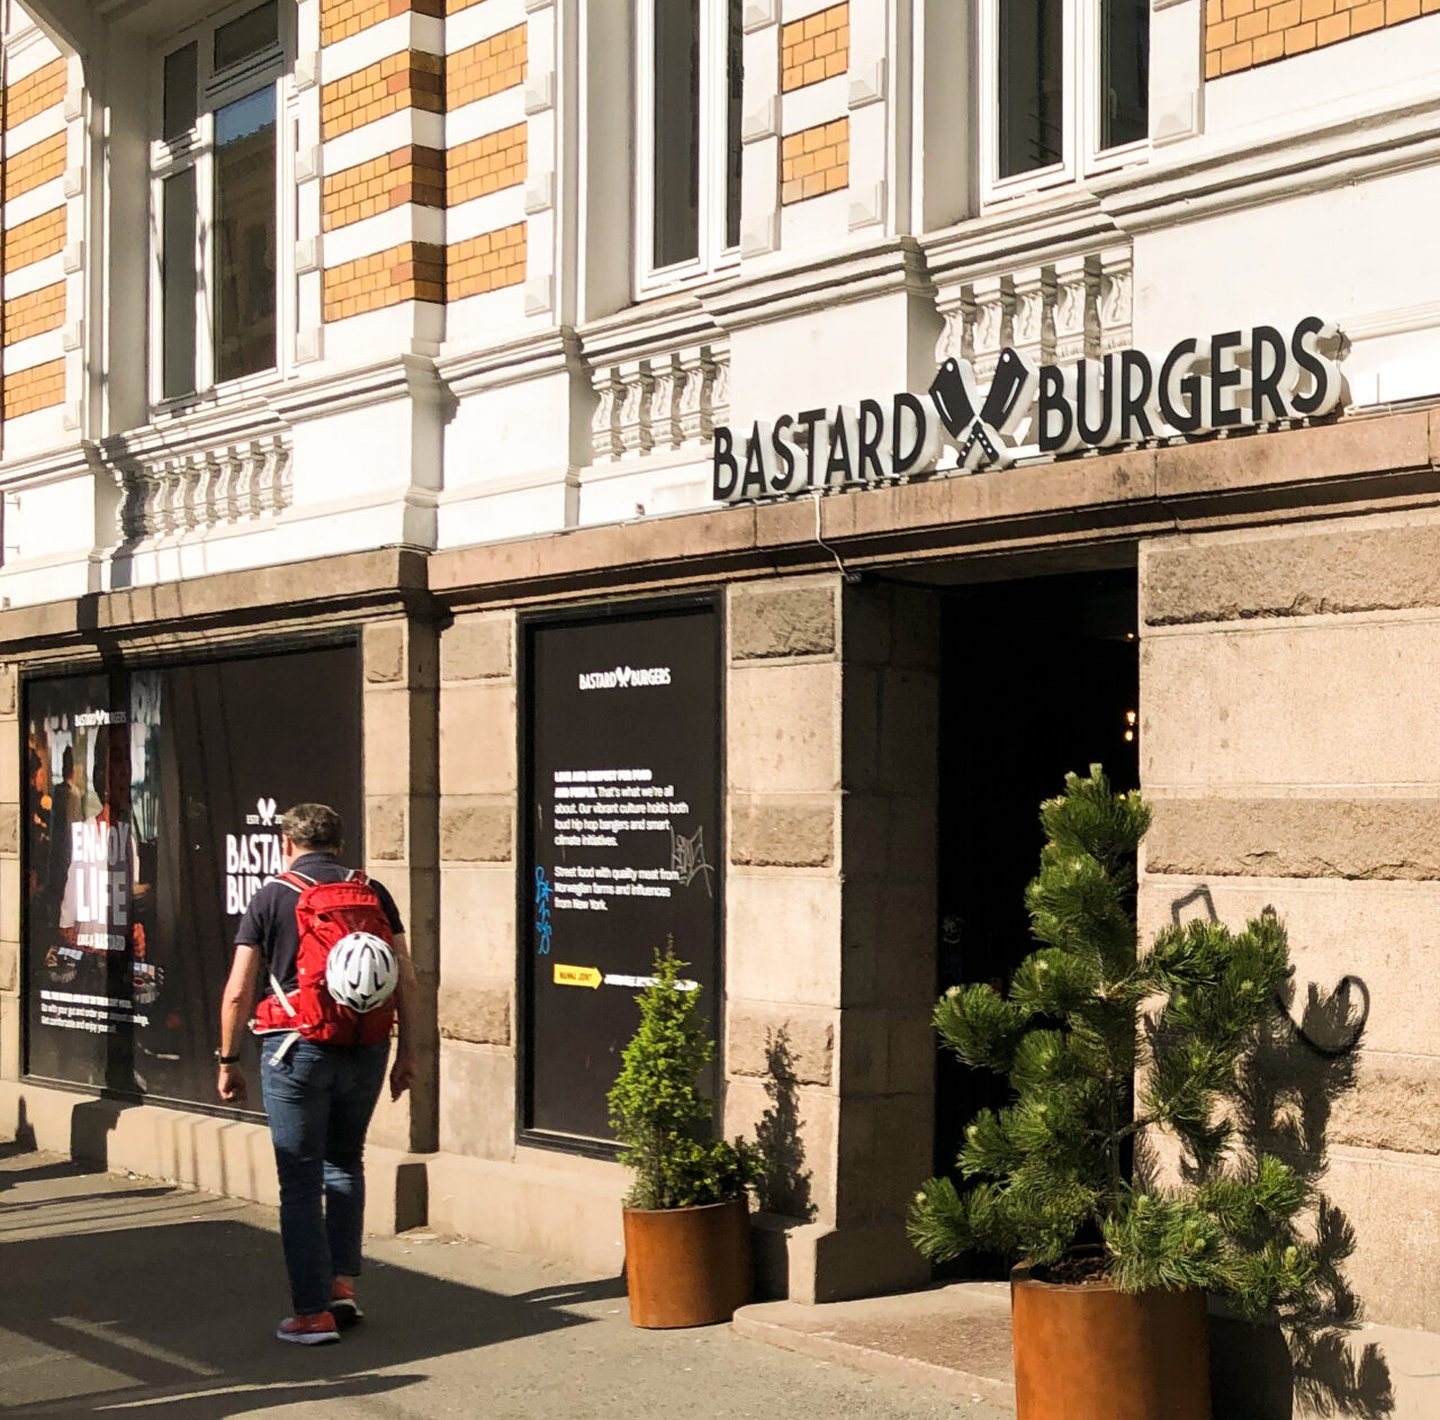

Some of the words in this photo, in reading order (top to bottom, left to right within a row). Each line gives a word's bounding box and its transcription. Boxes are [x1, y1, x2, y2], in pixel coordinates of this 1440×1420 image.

[711, 392, 930, 501] BASTARD
[1038, 316, 1333, 453] BURGERS
[579, 671, 617, 690] BASTARD
[630, 667, 671, 687] BURGERS
[629, 818, 645, 830] and
[71, 821, 130, 866] ENJOY
[226, 834, 289, 874] BASTA
[577, 866, 594, 878] food
[638, 868, 659, 880] meat
[76, 866, 127, 926] LIFE
[615, 884, 630, 895] and
[572, 898, 589, 909] New
